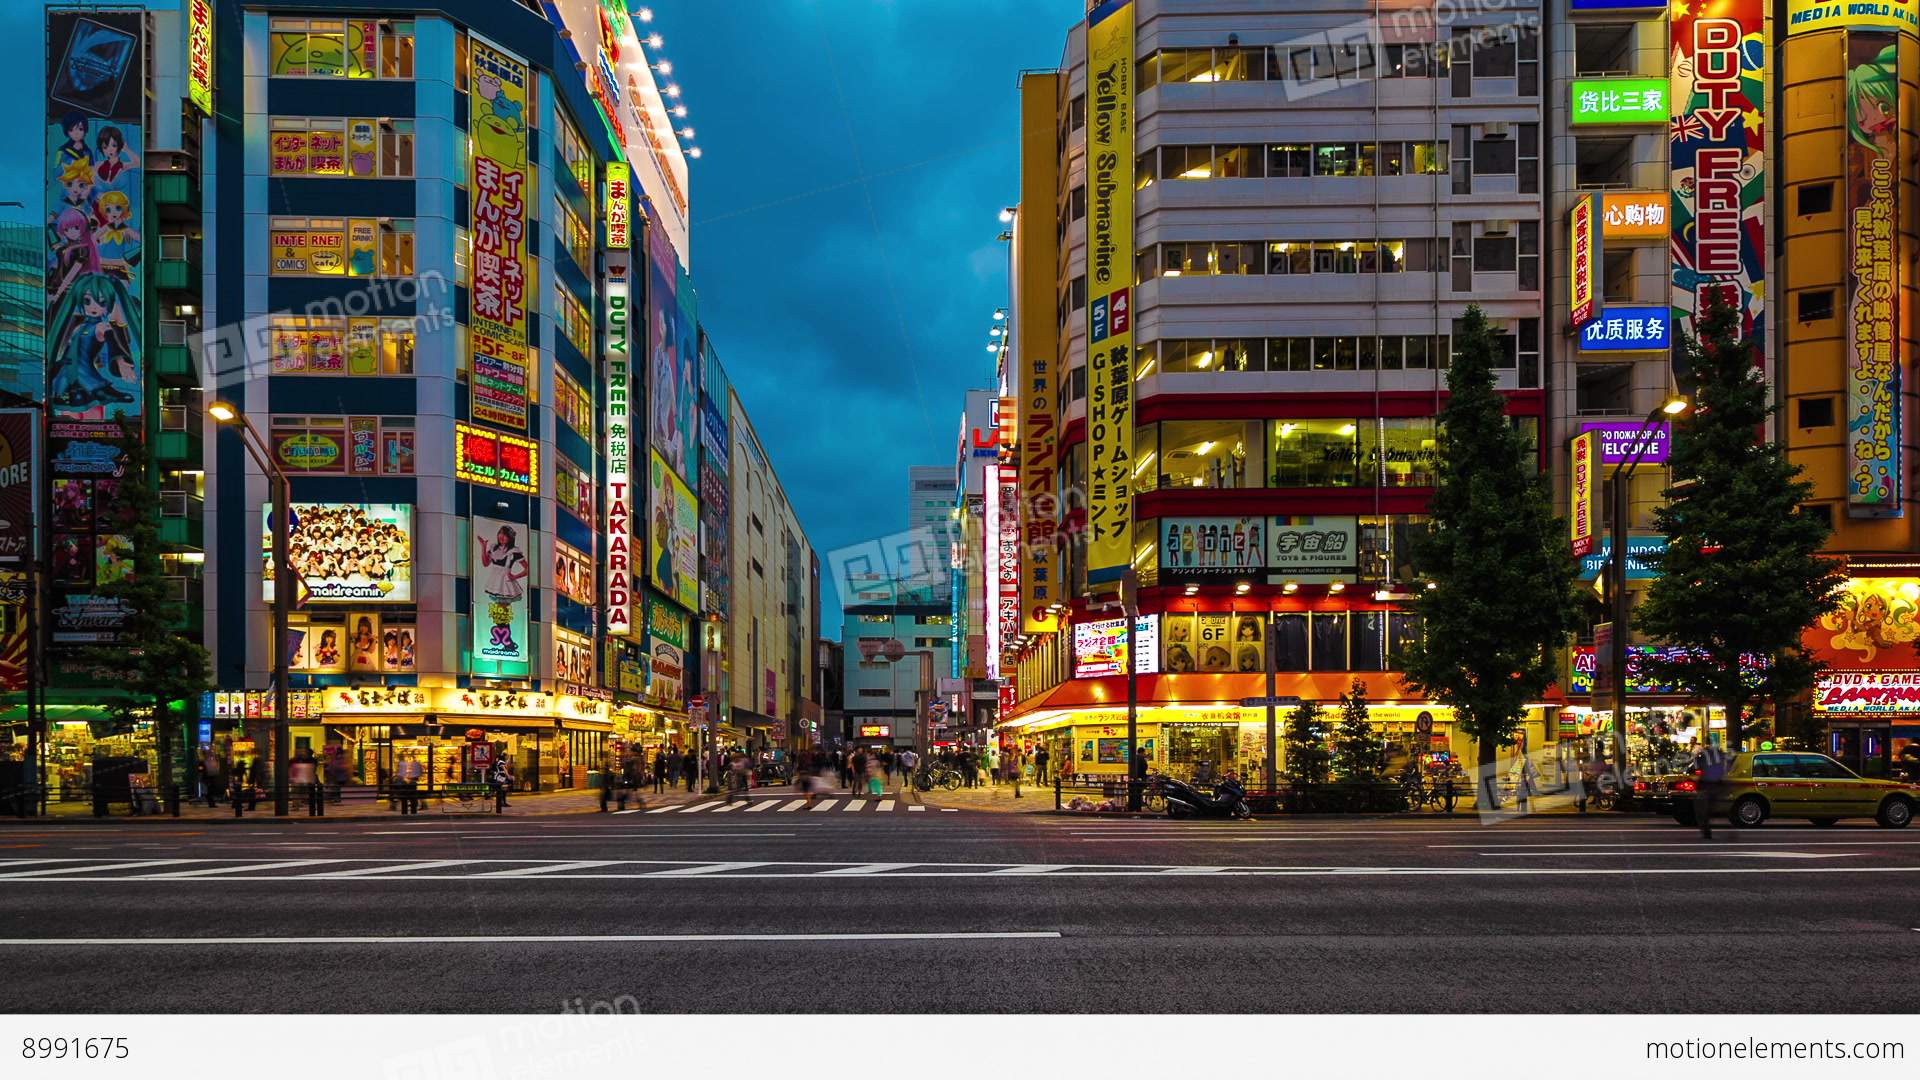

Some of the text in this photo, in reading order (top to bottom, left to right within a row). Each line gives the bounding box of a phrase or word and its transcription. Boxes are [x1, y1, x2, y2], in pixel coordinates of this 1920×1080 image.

[1791, 5, 1841, 24] MEDIA
[1848, 3, 1889, 15] WORLD
[1120, 57, 1128, 96] HOBBY
[1579, 90, 1663, 113] 货比三家
[275, 136, 342, 153] インターネット
[1694, 18, 1742, 274] DUTY FREE
[274, 155, 342, 172] まんが喫茶
[1095, 62, 1117, 282] Yellow Submarine
[610, 180, 626, 245] まんが喫茶
[1602, 204, 1665, 226] 心购物
[476, 157, 501, 319] まんが喫茶
[502, 172, 524, 326] インターネット
[276, 259, 305, 270] COMICS
[473, 316, 518, 338] INTERNET
[1586, 317, 1665, 341] 优质服务
[609, 296, 626, 416] DUTY FREE
[1031, 360, 1048, 410] 世界の
[610, 423, 627, 475] 免税店
[1110, 345, 1128, 538] 秋葉原ゲームショップ
[0, 461, 28, 488] ORE
[1027, 413, 1055, 546] ラジオ会館
[1576, 464, 1587, 536] DUTY FREE
[609, 482, 628, 624] TAKARADA
[1277, 531, 1348, 554] 宇宙船
[1033, 551, 1048, 601] 秋葉原
[1202, 628, 1224, 641] 6F
[1832, 674, 1863, 685] DVD
[357, 690, 411, 706] 富士そば
[479, 693, 528, 708] 富士そば
